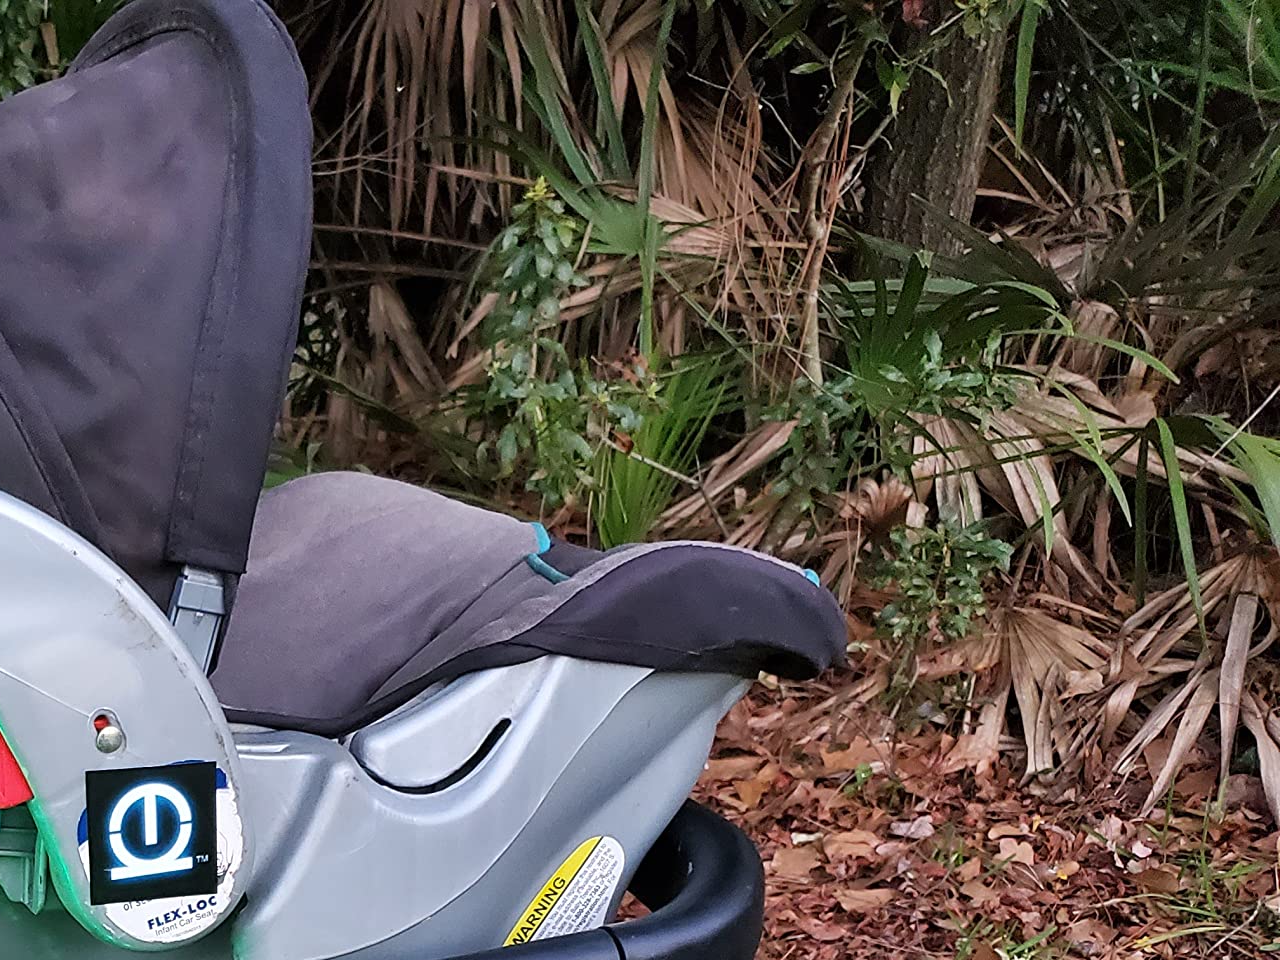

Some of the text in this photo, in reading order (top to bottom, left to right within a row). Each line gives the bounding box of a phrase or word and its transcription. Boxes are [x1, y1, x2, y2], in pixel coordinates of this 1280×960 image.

[147, 896, 217, 930] FLEX-LOC
[155, 924, 177, 936] Infant
[178, 916, 193, 927] Car
[195, 909, 214, 921] Seat
[511, 877, 566, 945] WARNING
